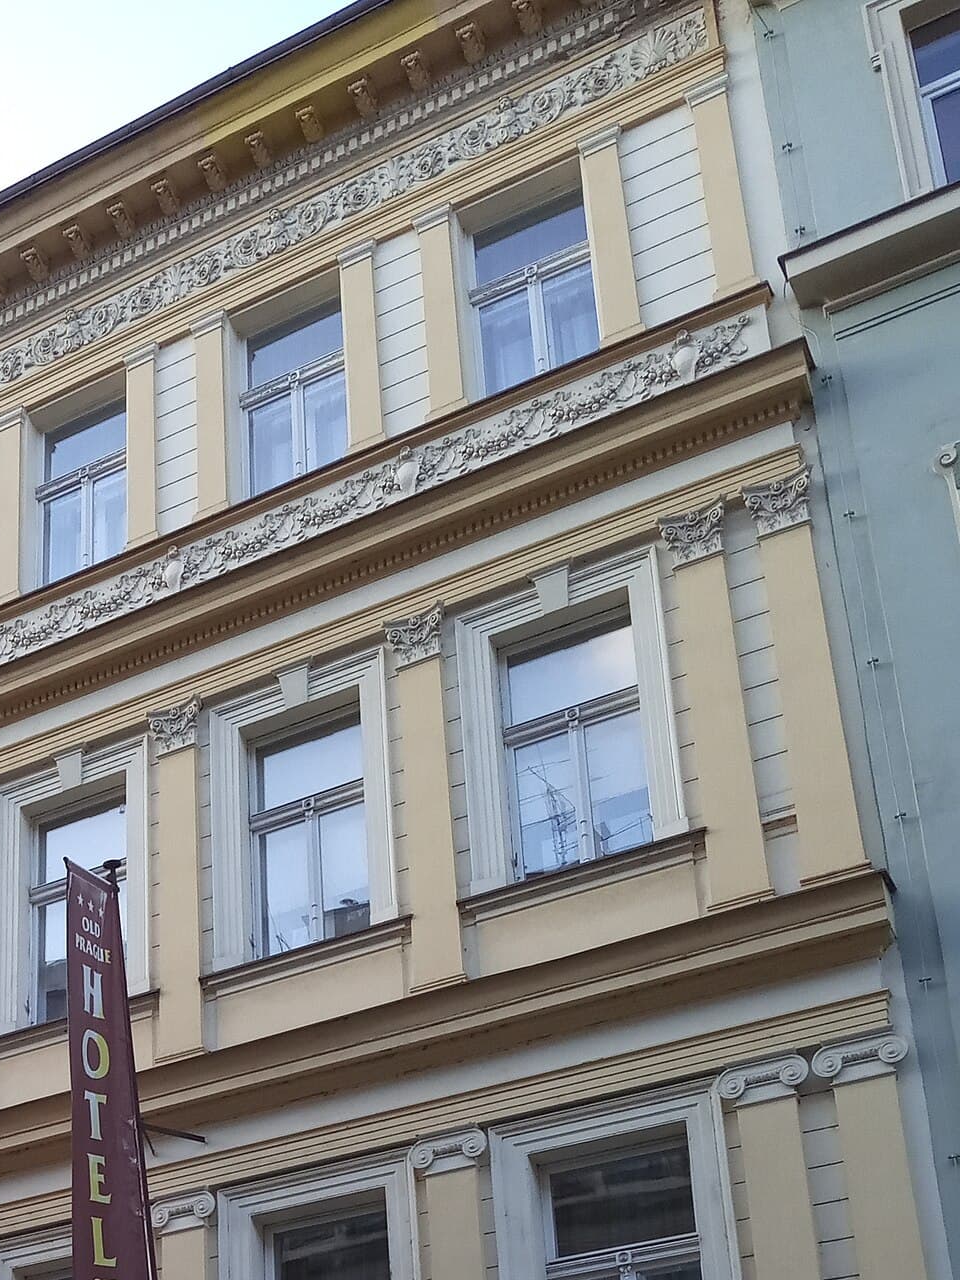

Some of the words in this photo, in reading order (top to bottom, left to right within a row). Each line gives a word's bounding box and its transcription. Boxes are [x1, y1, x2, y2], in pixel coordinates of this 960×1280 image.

[82, 916, 101, 938] OLD
[75, 932, 112, 964] PRAGUE
[81, 963, 117, 1268] HOTEL
